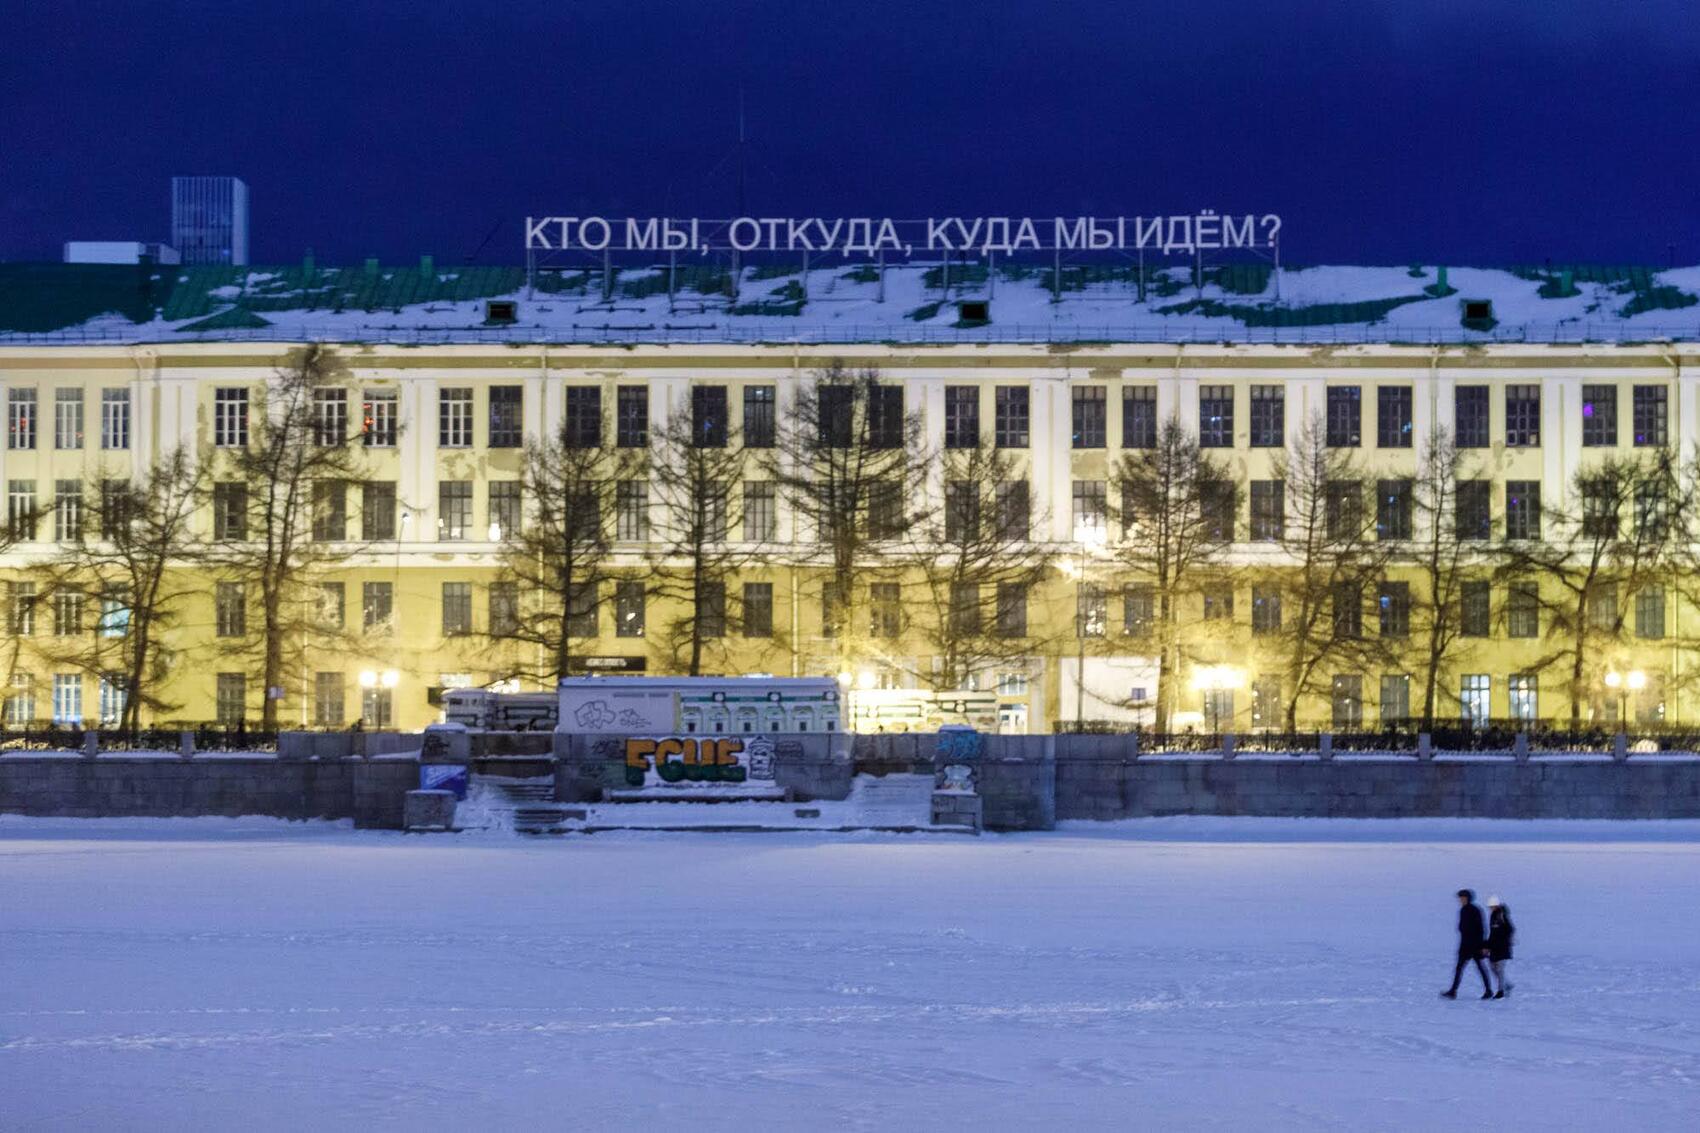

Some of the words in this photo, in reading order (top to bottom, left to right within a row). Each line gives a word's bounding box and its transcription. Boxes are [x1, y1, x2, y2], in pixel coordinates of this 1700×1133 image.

[525, 216, 611, 250] КТО
[626, 217, 709, 255] МЫ,
[729, 217, 912, 257] ОТКУДА,
[927, 217, 1041, 256] КУДА
[1054, 216, 1125, 250] МЫ
[1136, 209, 1282, 255] ИДЁМ?
